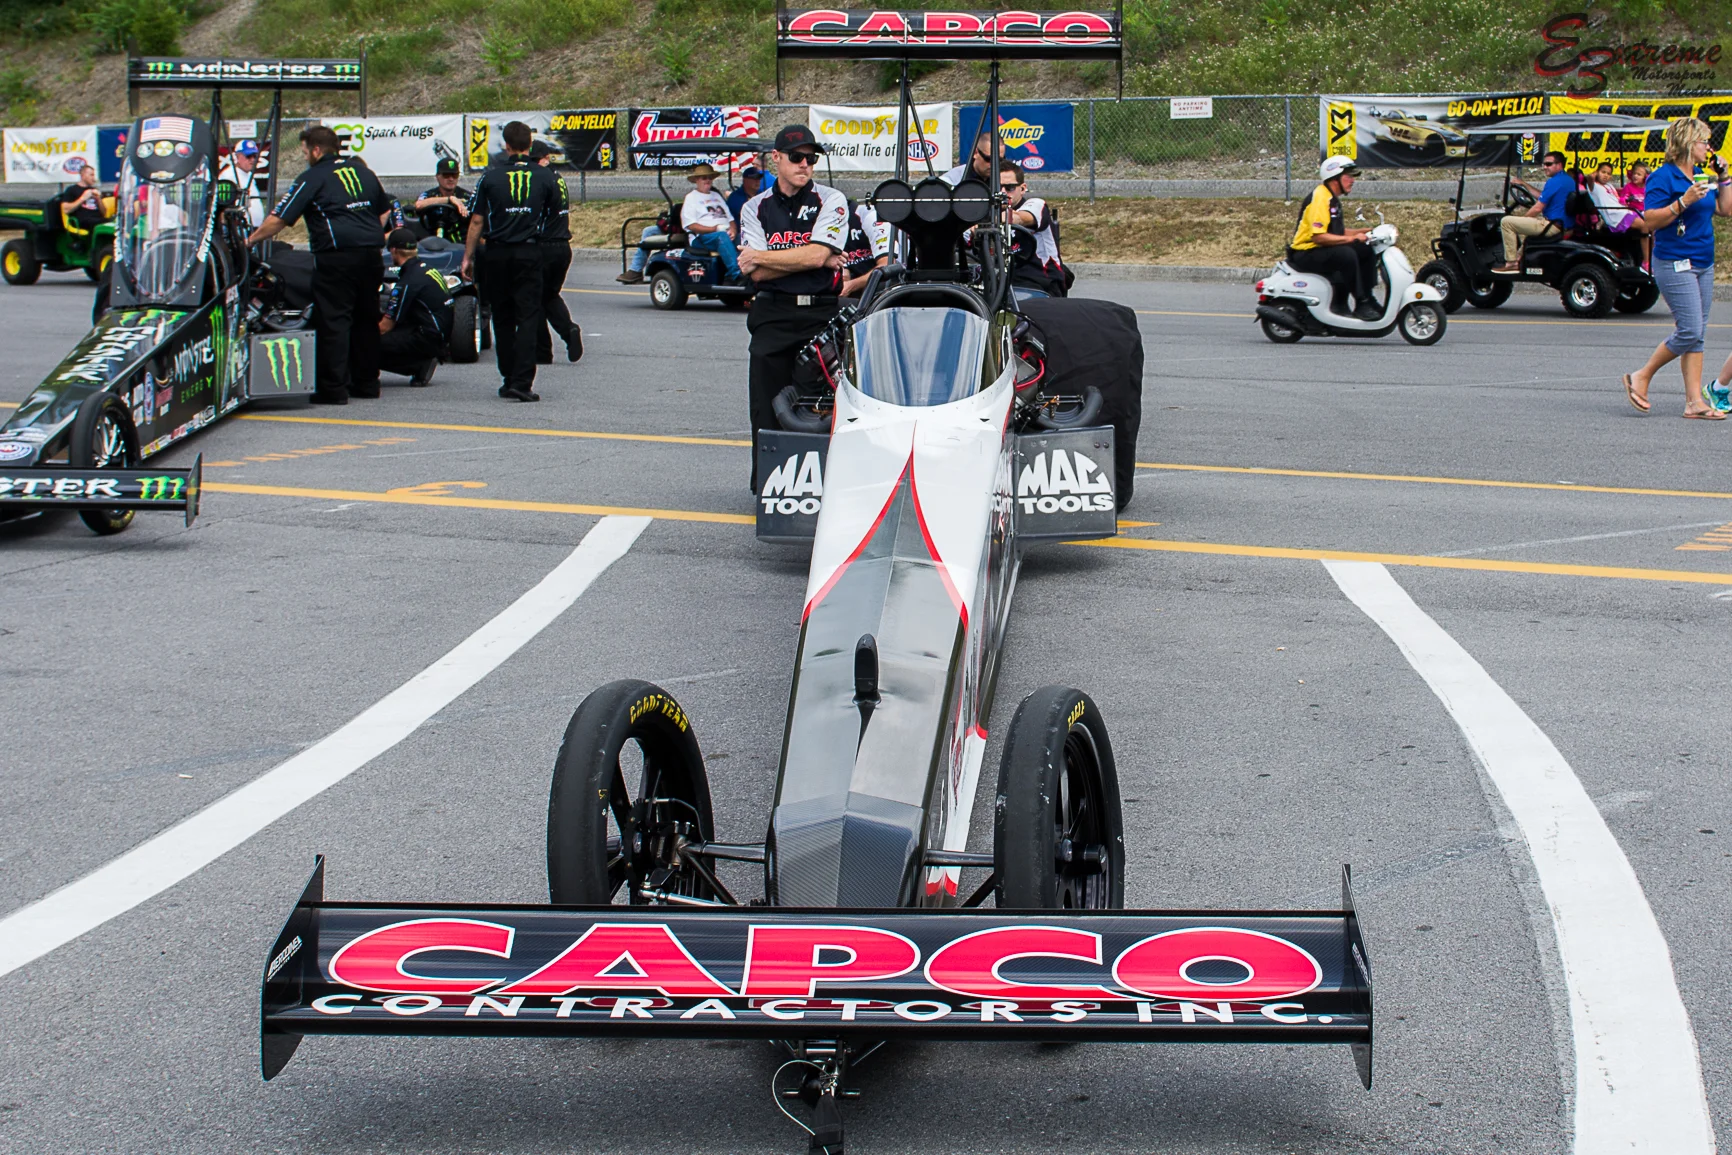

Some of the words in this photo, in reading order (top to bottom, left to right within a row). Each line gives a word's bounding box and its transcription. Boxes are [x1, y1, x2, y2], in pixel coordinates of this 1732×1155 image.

[788, 10, 1112, 44] CAPCO
[1447, 97, 1544, 117] GO-ON-YELLO!
[364, 126, 397, 140] Spark
[400, 125, 434, 139] Plugs
[820, 117, 938, 137] GOODYAR
[998, 127, 1042, 139] UNOCO
[822, 143, 860, 156] ficial
[863, 143, 881, 157] Tire
[884, 143, 897, 157] of
[645, 158, 678, 166] RACNG
[766, 230, 812, 245] APCO
[761, 450, 822, 497] MA
[1017, 449, 1114, 496] MAC
[761, 498, 821, 514] TOO
[1017, 494, 1115, 515] TOOLS
[630, 693, 689, 733] GOODYEAR
[327, 917, 1323, 1001] CAPCO
[311, 993, 1088, 1023] CONTRACTORS
[1138, 1000, 1334, 1024] INC.
